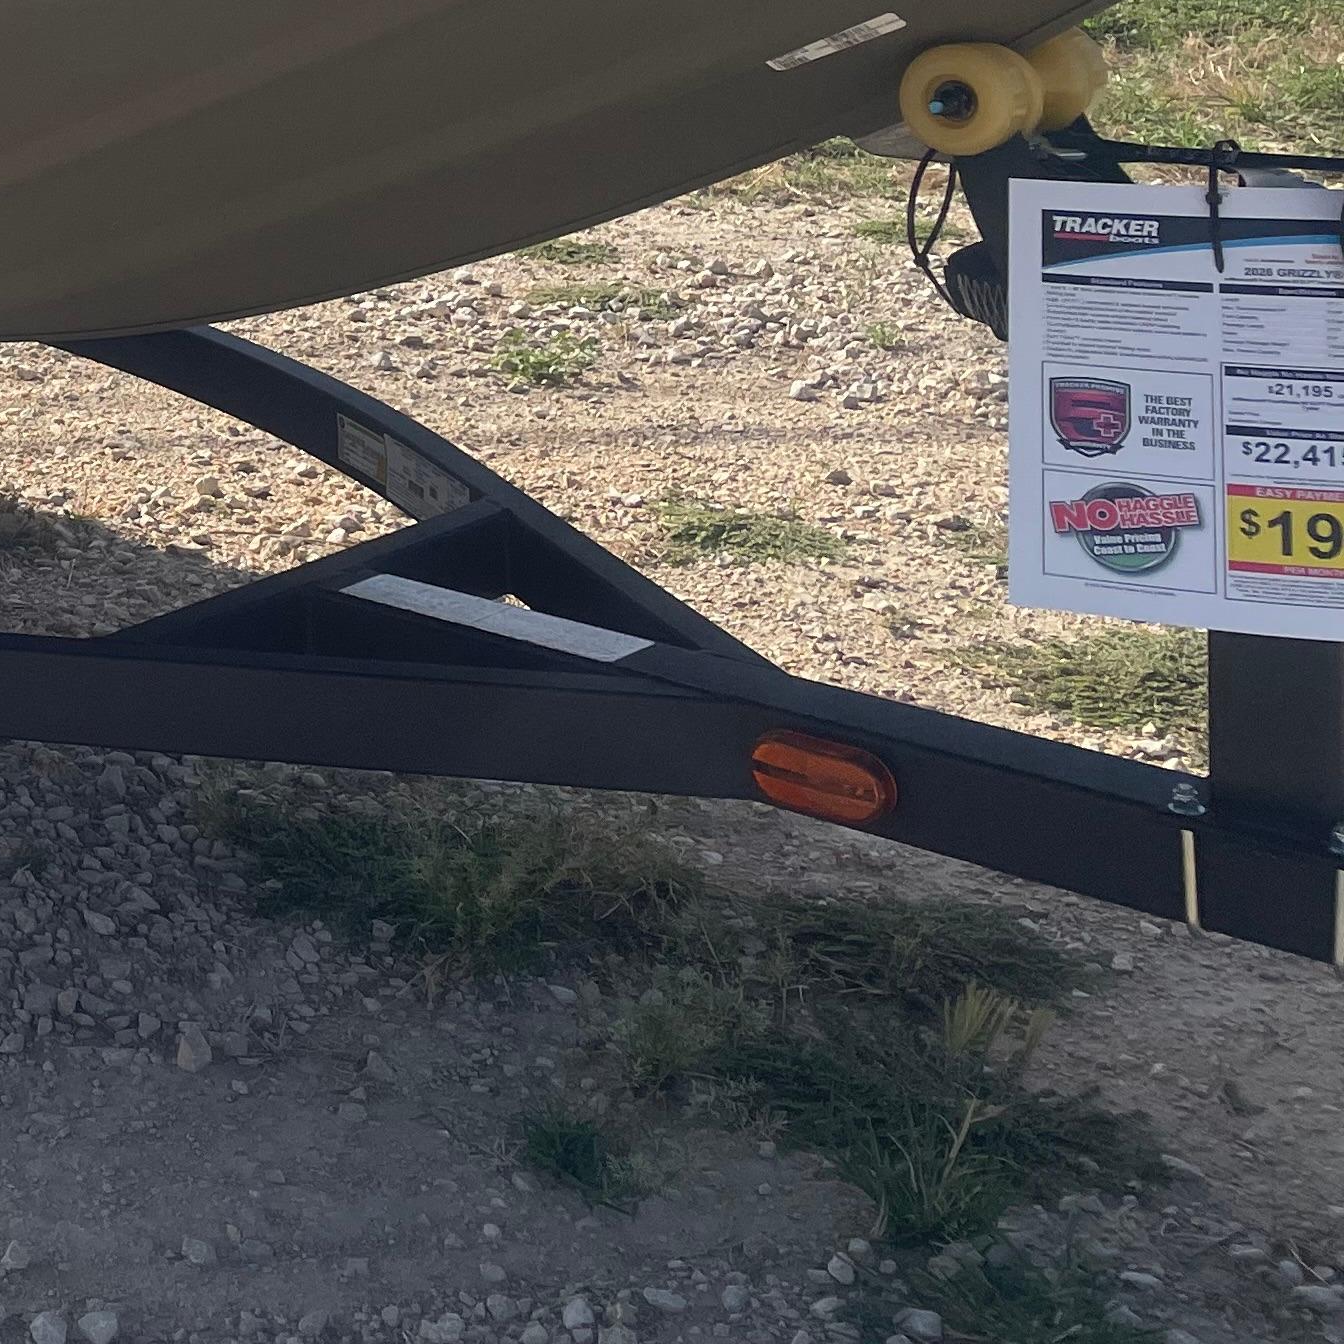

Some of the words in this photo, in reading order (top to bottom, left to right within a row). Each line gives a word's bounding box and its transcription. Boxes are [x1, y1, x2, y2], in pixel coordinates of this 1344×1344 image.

[1052, 215, 1160, 237] TRACKER
[1109, 235, 1160, 244] boats
[1267, 383, 1333, 398] $21,195
[1144, 394, 1163, 405] THE
[1165, 396, 1193, 407] BEST
[1145, 406, 1192, 417] FACTORY
[1138, 416, 1199, 429] WARRANTY
[1151, 428, 1163, 438] IN
[1166, 429, 1186, 439] THE
[1142, 438, 1196, 451] BUSINESS
[1241, 441, 1344, 468] $22,41
[1255, 487, 1294, 499] EASY
[1052, 499, 1119, 531] NO
[1117, 495, 1195, 512] HAGGLE
[1120, 510, 1199, 528] HASSLE
[1094, 534, 1123, 545] Value
[1124, 533, 1162, 544] Pricing
[1240, 508, 1344, 560] $19
[1093, 545, 1123, 555] Coast
[1124, 544, 1135, 554] to
[1136, 543, 1166, 553] Coast
